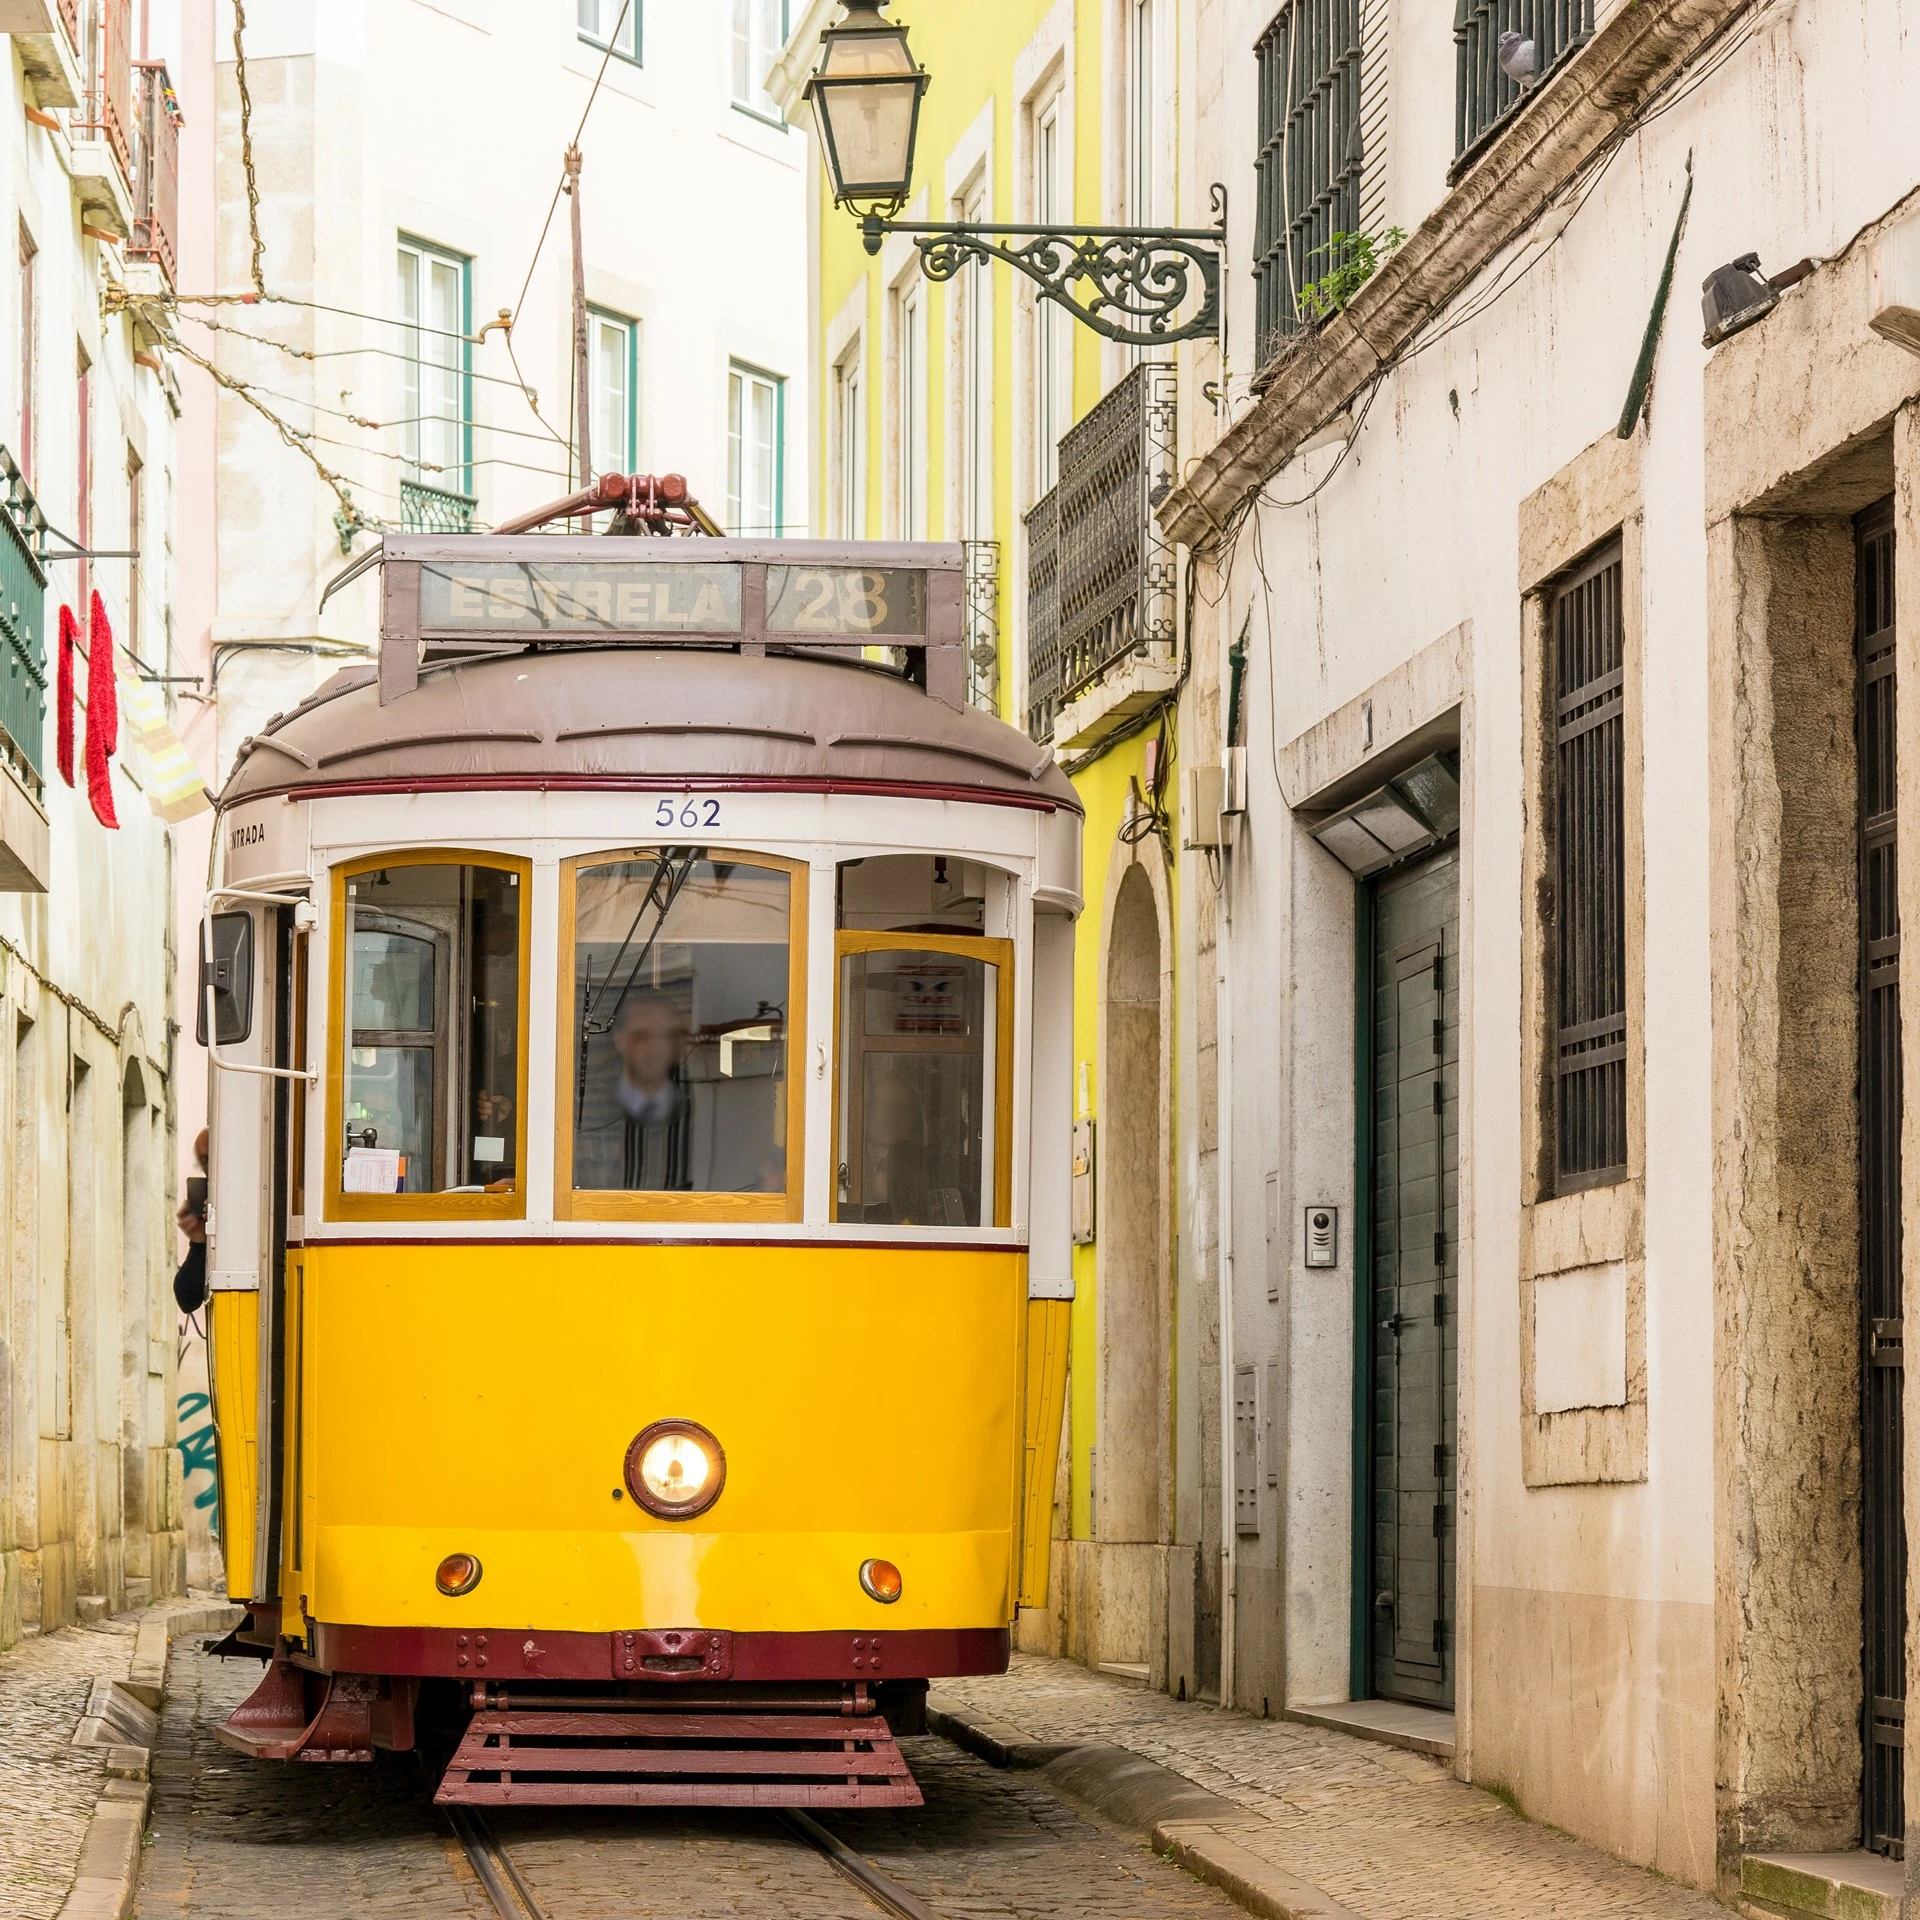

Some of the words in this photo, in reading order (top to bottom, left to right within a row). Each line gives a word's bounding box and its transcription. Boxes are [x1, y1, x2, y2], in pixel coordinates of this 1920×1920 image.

[450, 577, 730, 622] ESTRELA
[794, 570, 888, 629] 28
[655, 798, 720, 828] 562
